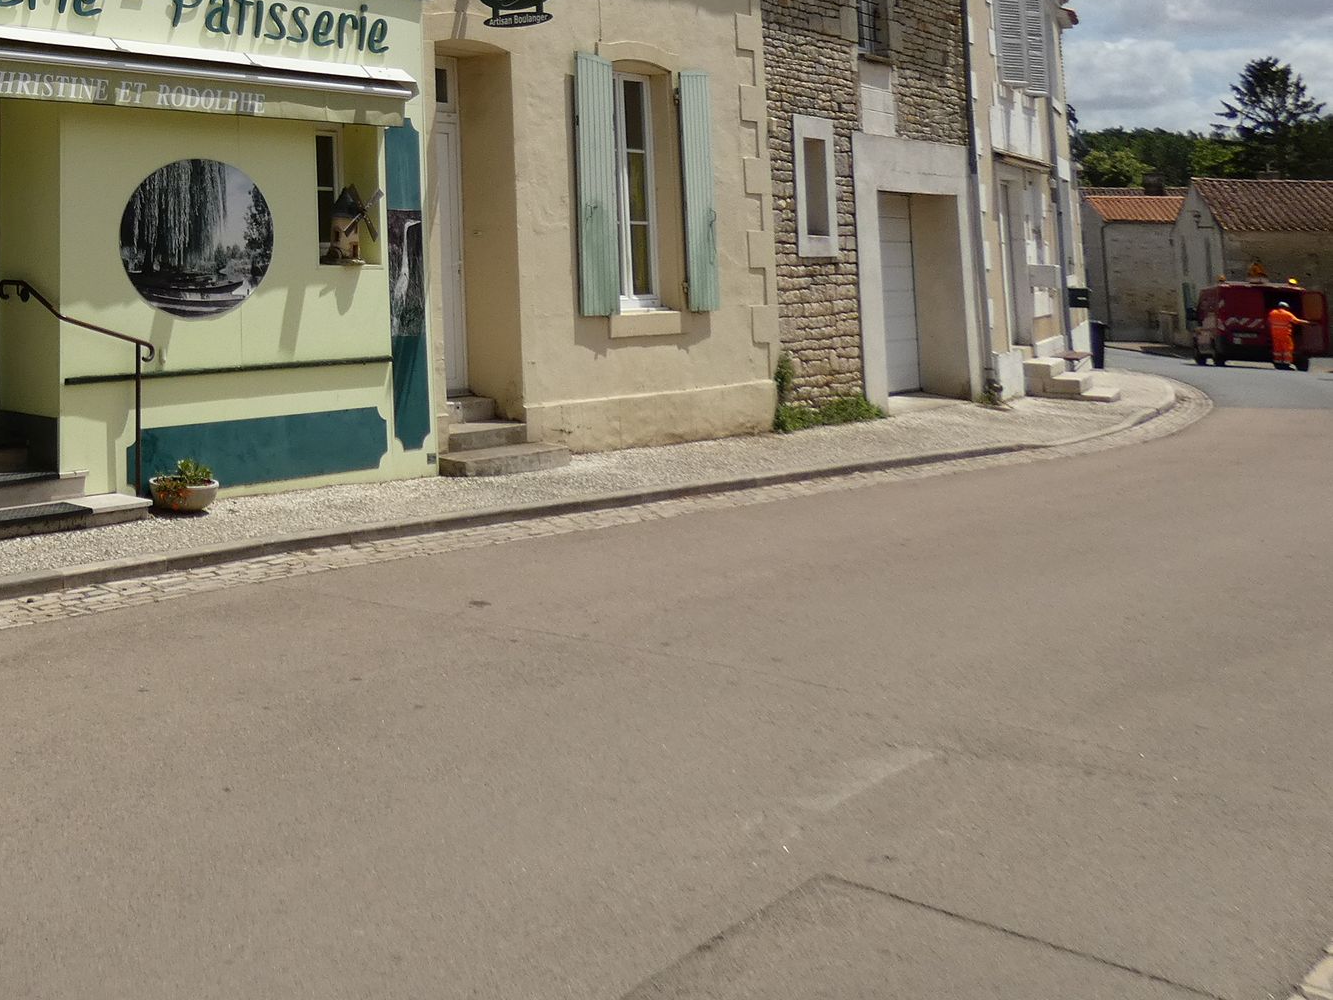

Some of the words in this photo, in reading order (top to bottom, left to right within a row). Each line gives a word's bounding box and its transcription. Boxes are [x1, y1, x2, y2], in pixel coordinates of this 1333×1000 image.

[489, 17, 513, 26] Artisan
[513, 13, 548, 24] Boulanger
[115, 80, 148, 107] ET
[157, 84, 267, 114] RODOLPHE
